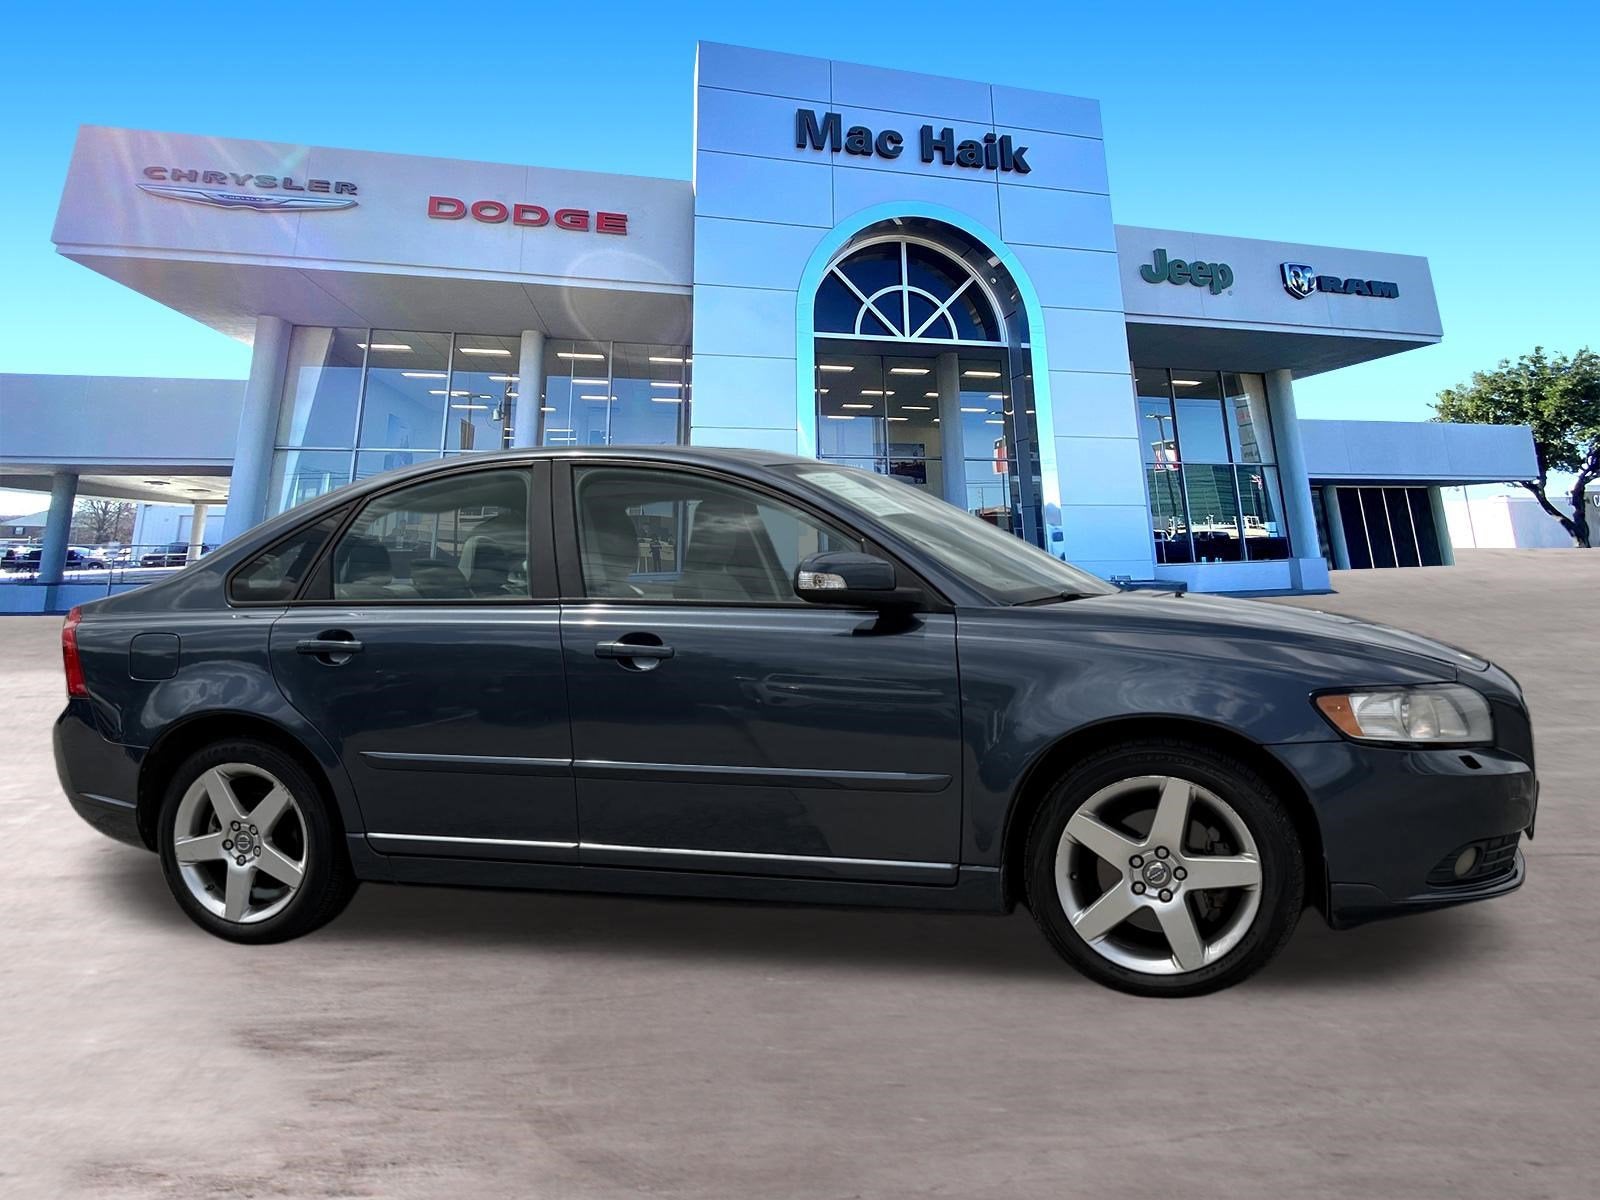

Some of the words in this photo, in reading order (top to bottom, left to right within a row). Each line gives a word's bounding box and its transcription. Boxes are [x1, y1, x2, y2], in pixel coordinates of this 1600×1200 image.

[796, 108, 904, 159] Mac
[920, 125, 1032, 174] Haik
[143, 166, 359, 195] CHRYSLER
[428, 195, 628, 236] DODGE
[1140, 248, 1234, 296] Jeep
[1315, 275, 1400, 299] RAM
